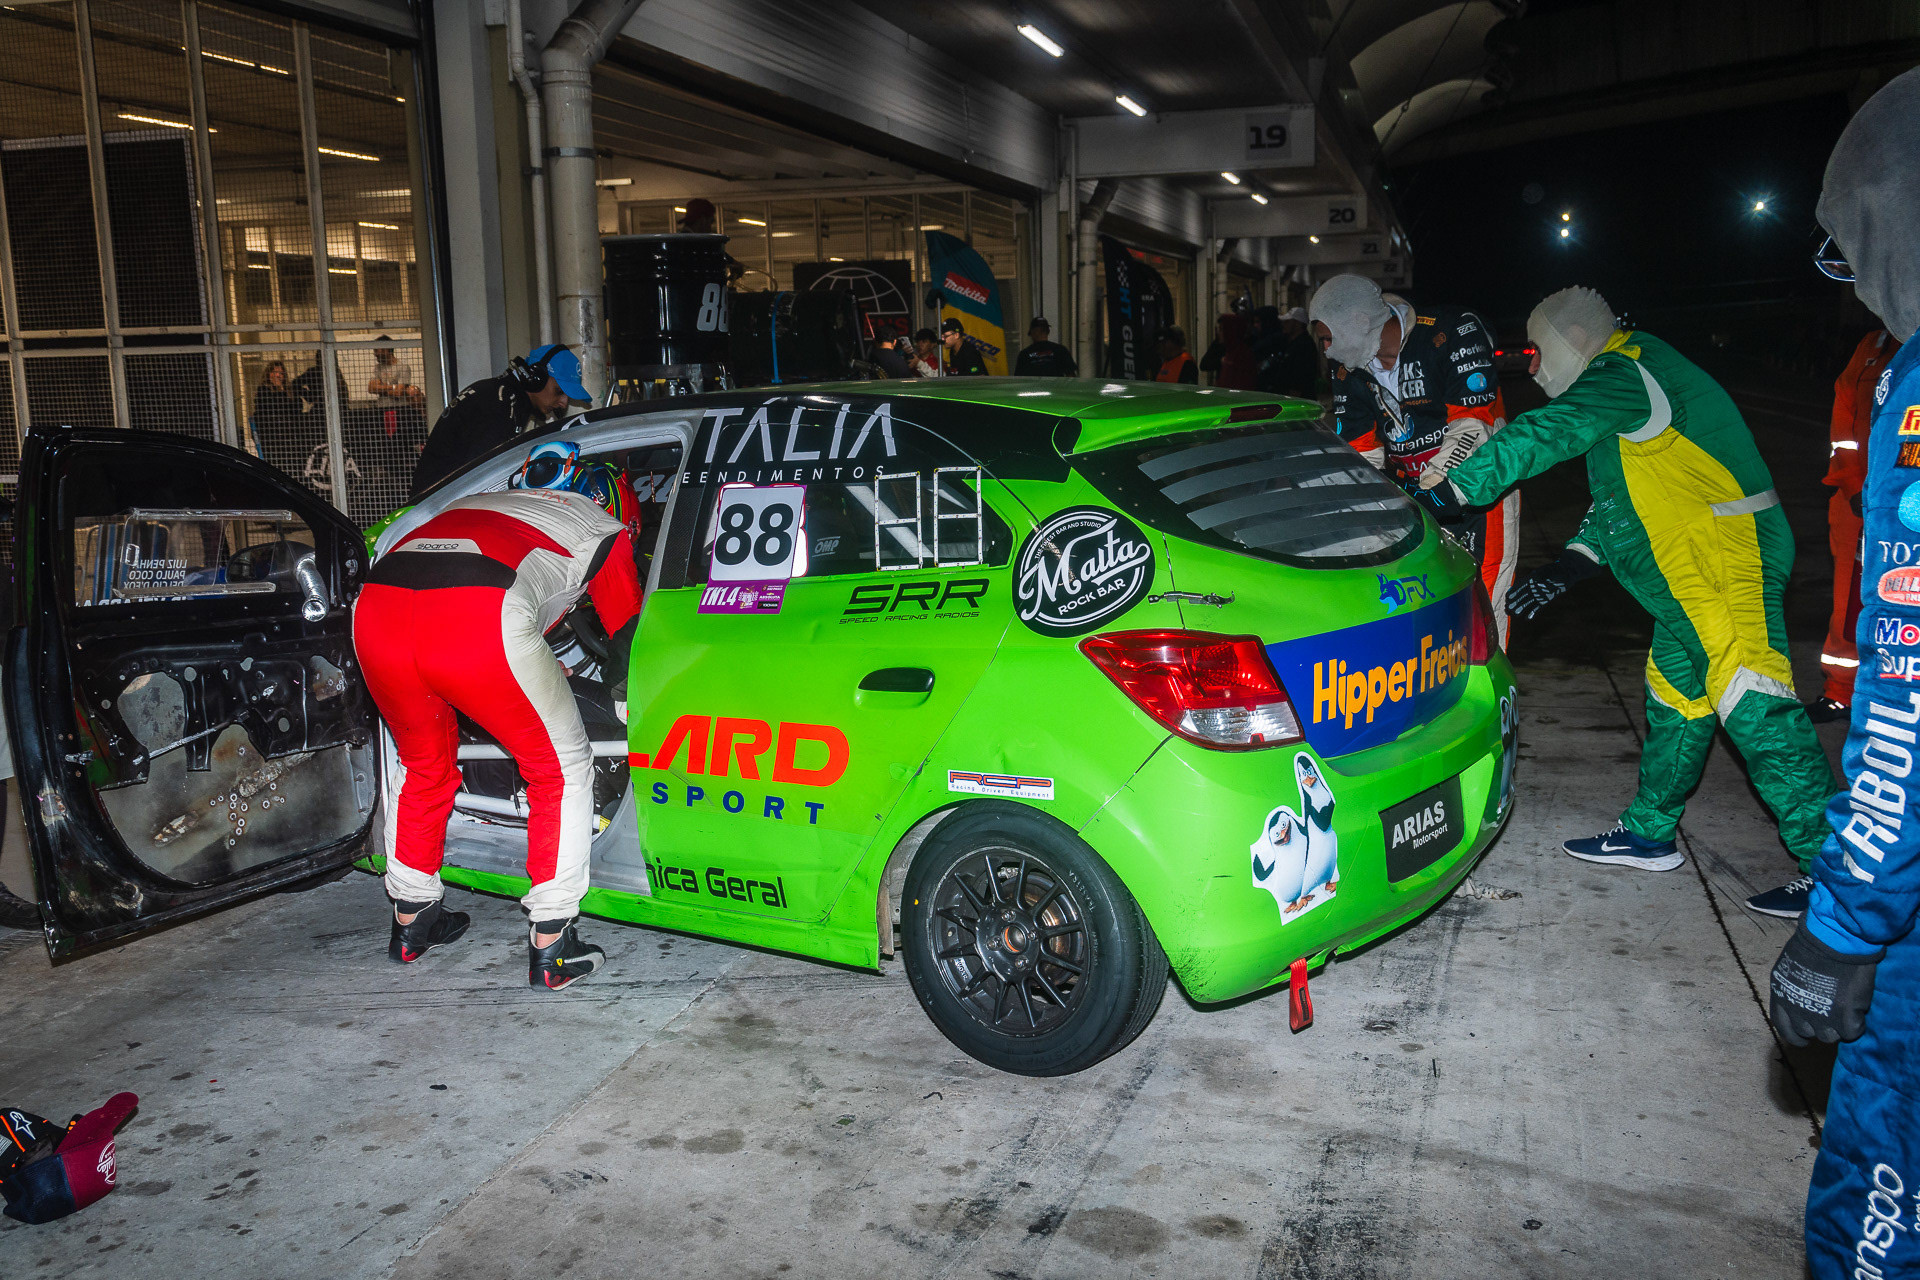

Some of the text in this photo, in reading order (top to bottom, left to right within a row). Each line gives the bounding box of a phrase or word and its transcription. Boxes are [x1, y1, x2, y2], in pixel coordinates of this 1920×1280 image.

[1249, 125, 1287, 150] 19
[1328, 208, 1356, 224] 20
[1362, 243, 1379, 254] 21
[1461, 392, 1496, 406] TOTVS
[416, 542, 460, 551] sparco
[714, 503, 794, 566] 88
[814, 539, 840, 554] OMP
[1034, 548, 1044, 560] THE
[1055, 525, 1068, 535] BAR
[1067, 521, 1080, 531] AND
[843, 578, 990, 615] SRR
[1057, 578, 1126, 616] ROCK BAR
[838, 611, 981, 625] SPEED RACING RADIOS
[1313, 629, 1468, 730] Hipper Freios
[949, 771, 1052, 789] RCP
[951, 784, 975, 792] Racing
[1010, 790, 1049, 798] Equipment
[651, 782, 825, 825] SPORT
[1391, 800, 1445, 850] ARIAS
[1412, 822, 1448, 850] Motorsport
[705, 866, 788, 909] Geral
